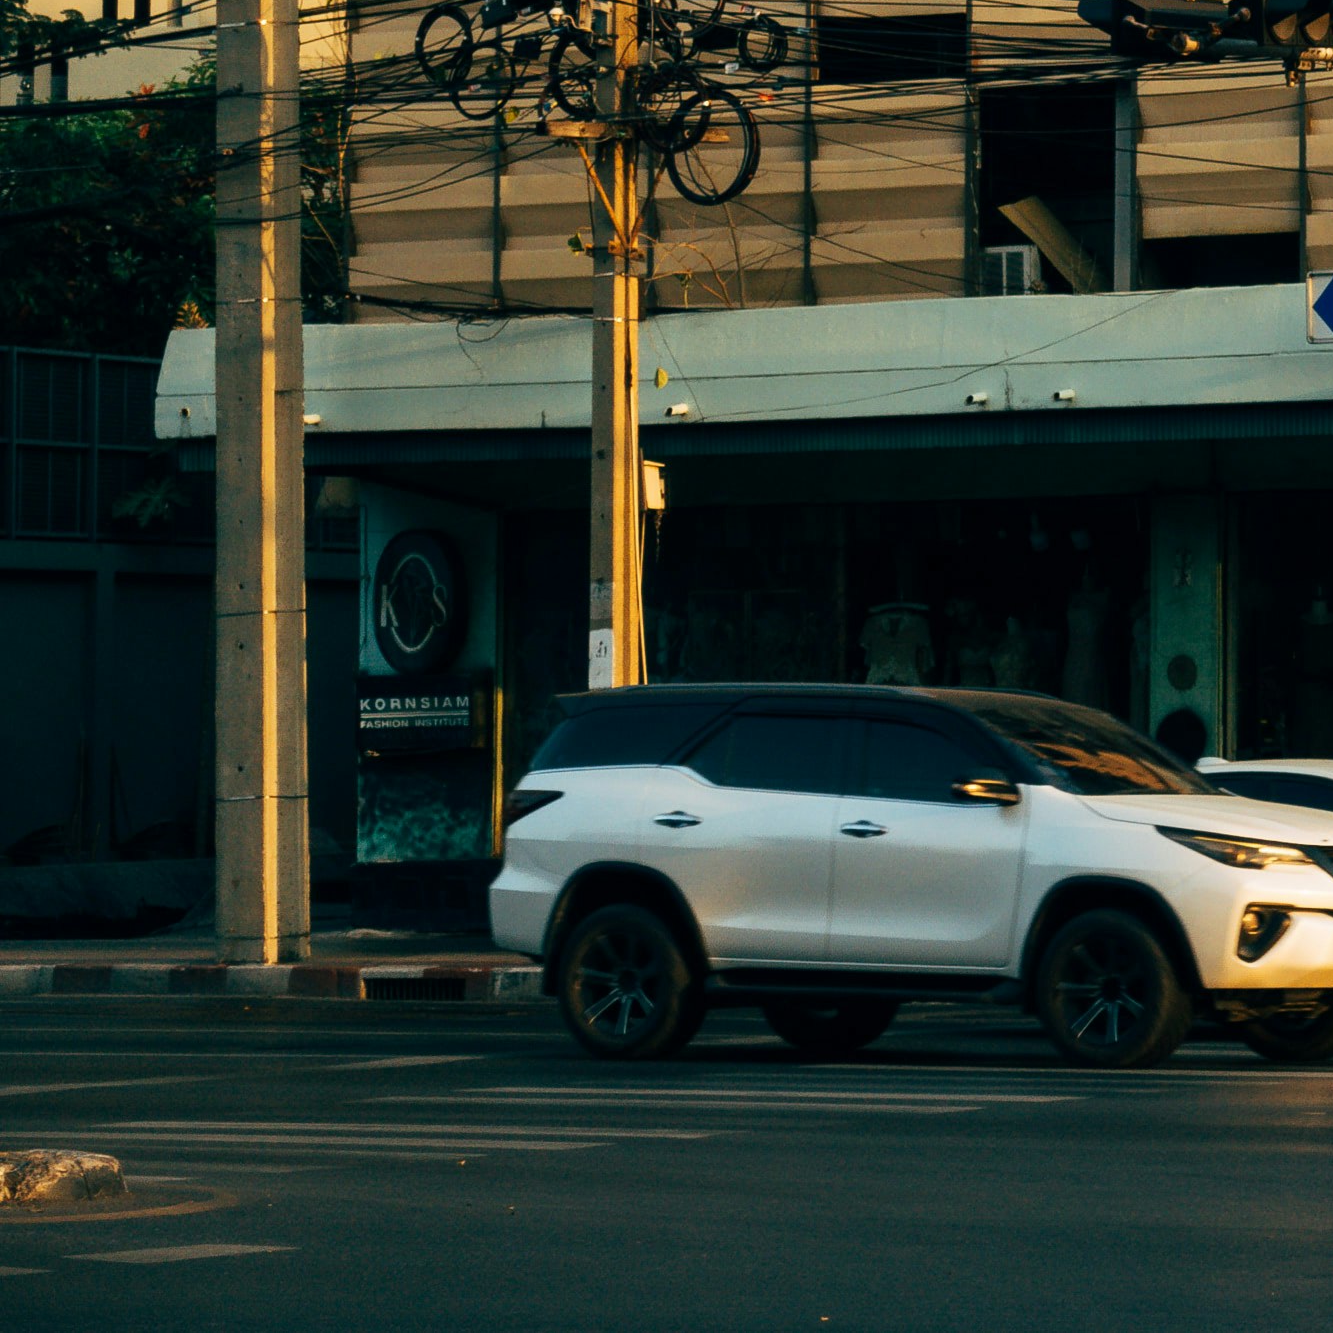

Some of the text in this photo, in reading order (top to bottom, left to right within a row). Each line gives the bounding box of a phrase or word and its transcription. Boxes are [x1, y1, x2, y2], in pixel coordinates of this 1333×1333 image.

[359, 695, 470, 711] KORNSIAM
[359, 717, 471, 729] FASHION INSTITUTE
